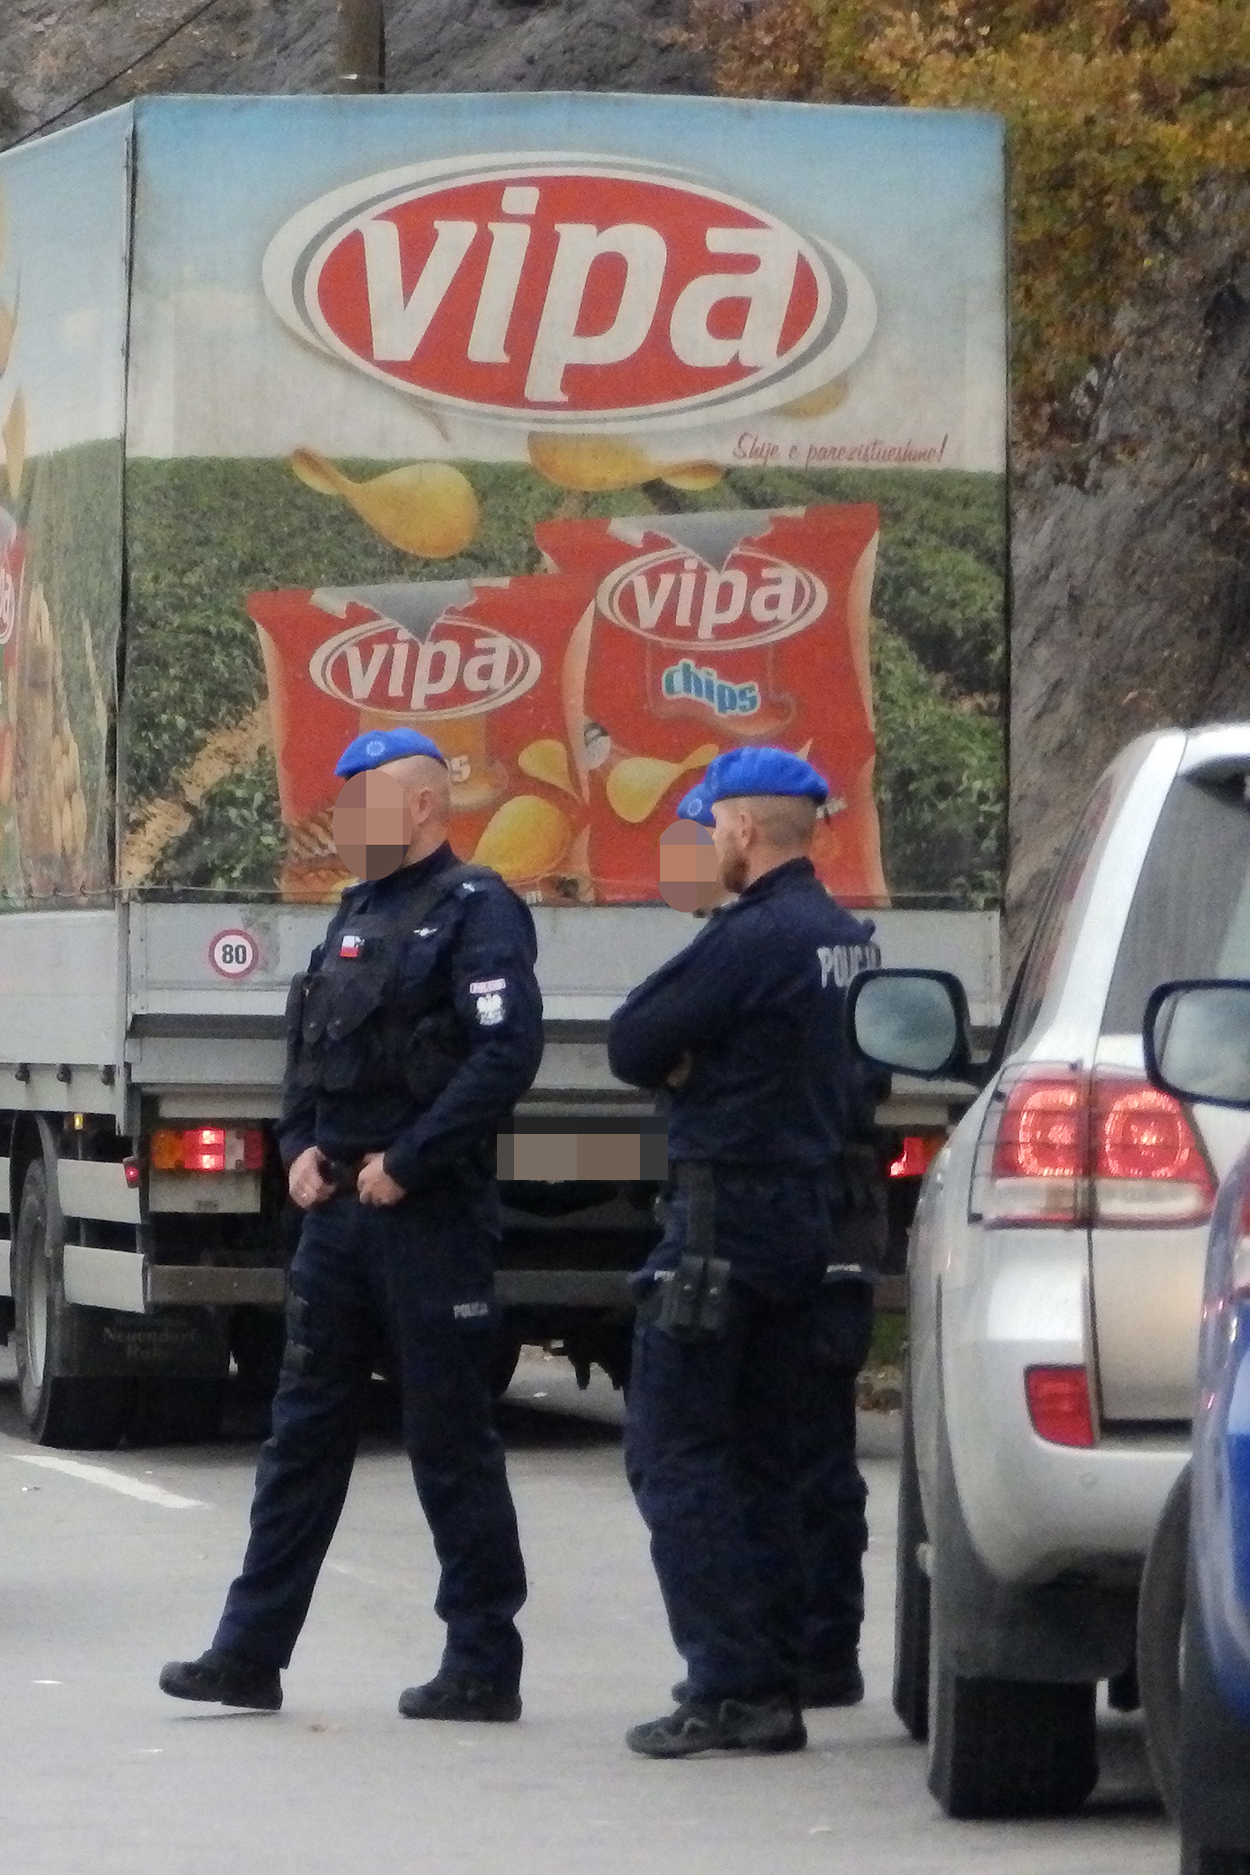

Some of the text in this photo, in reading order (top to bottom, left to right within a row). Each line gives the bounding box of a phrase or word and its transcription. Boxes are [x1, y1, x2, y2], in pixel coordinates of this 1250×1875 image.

[355, 185, 804, 403] vipa
[632, 559, 800, 640] vipa
[349, 626, 514, 709] vipa
[663, 659, 760, 716] chips
[221, 944, 247, 965] 80
